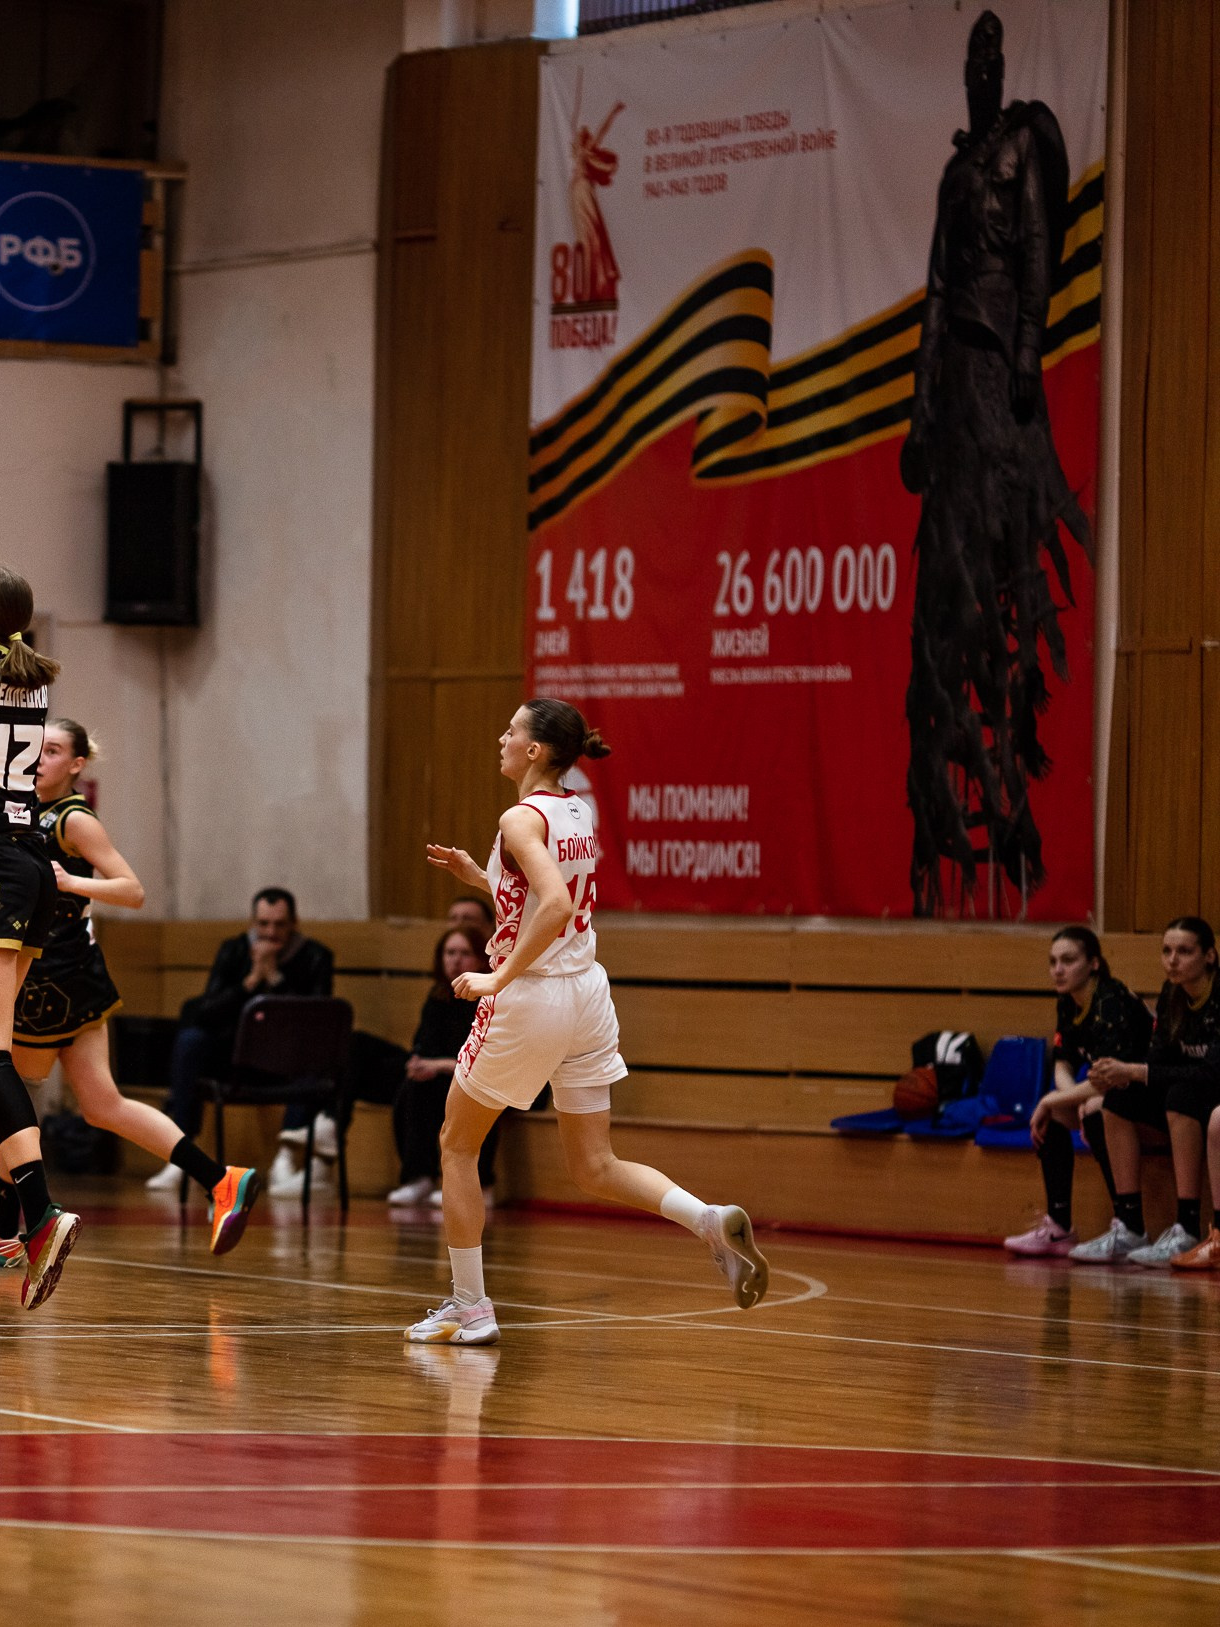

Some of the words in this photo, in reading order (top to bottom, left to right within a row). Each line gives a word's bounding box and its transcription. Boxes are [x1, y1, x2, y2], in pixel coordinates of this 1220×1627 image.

[536, 549, 556, 620] 1
[566, 547, 635, 620] 418
[713, 550, 754, 616] 26
[763, 546, 825, 615] 600
[832, 543, 897, 613] 000
[627, 785, 660, 821] МЫ
[661, 785, 750, 822] ПОМНИМ!
[626, 840, 660, 877] МЫ
